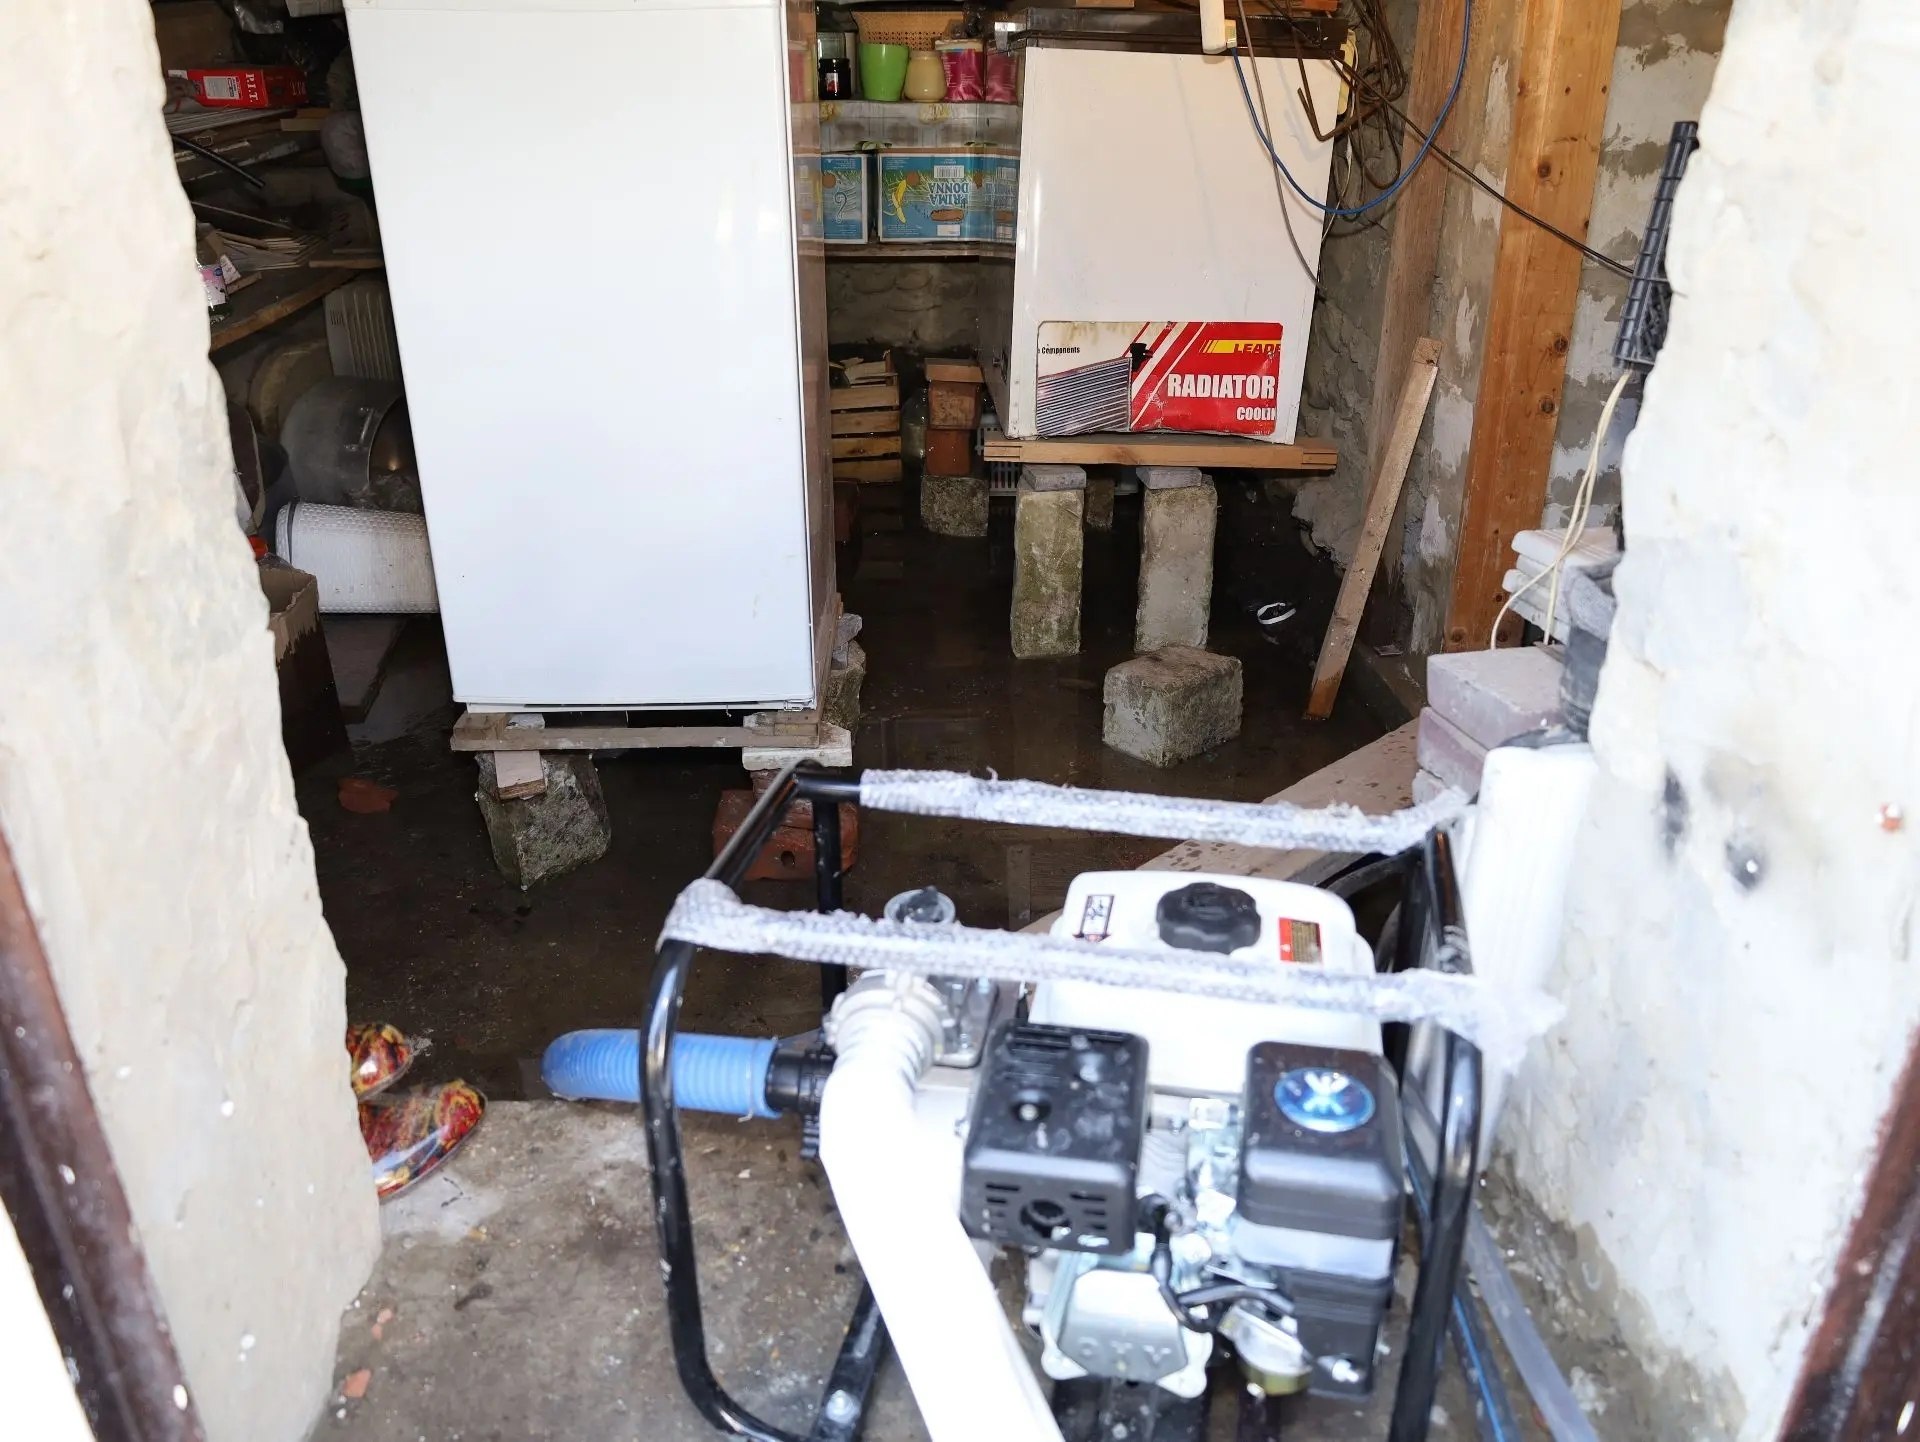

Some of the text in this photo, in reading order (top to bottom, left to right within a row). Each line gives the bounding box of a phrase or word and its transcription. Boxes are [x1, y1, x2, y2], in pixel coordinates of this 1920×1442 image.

[246, 73, 258, 103] P.I.T.
[928, 181, 969, 194] DONNA
[929, 193, 968, 207] PRIMA
[1041, 346, 1080, 355] Components
[1168, 374, 1275, 399] RADIATOR
